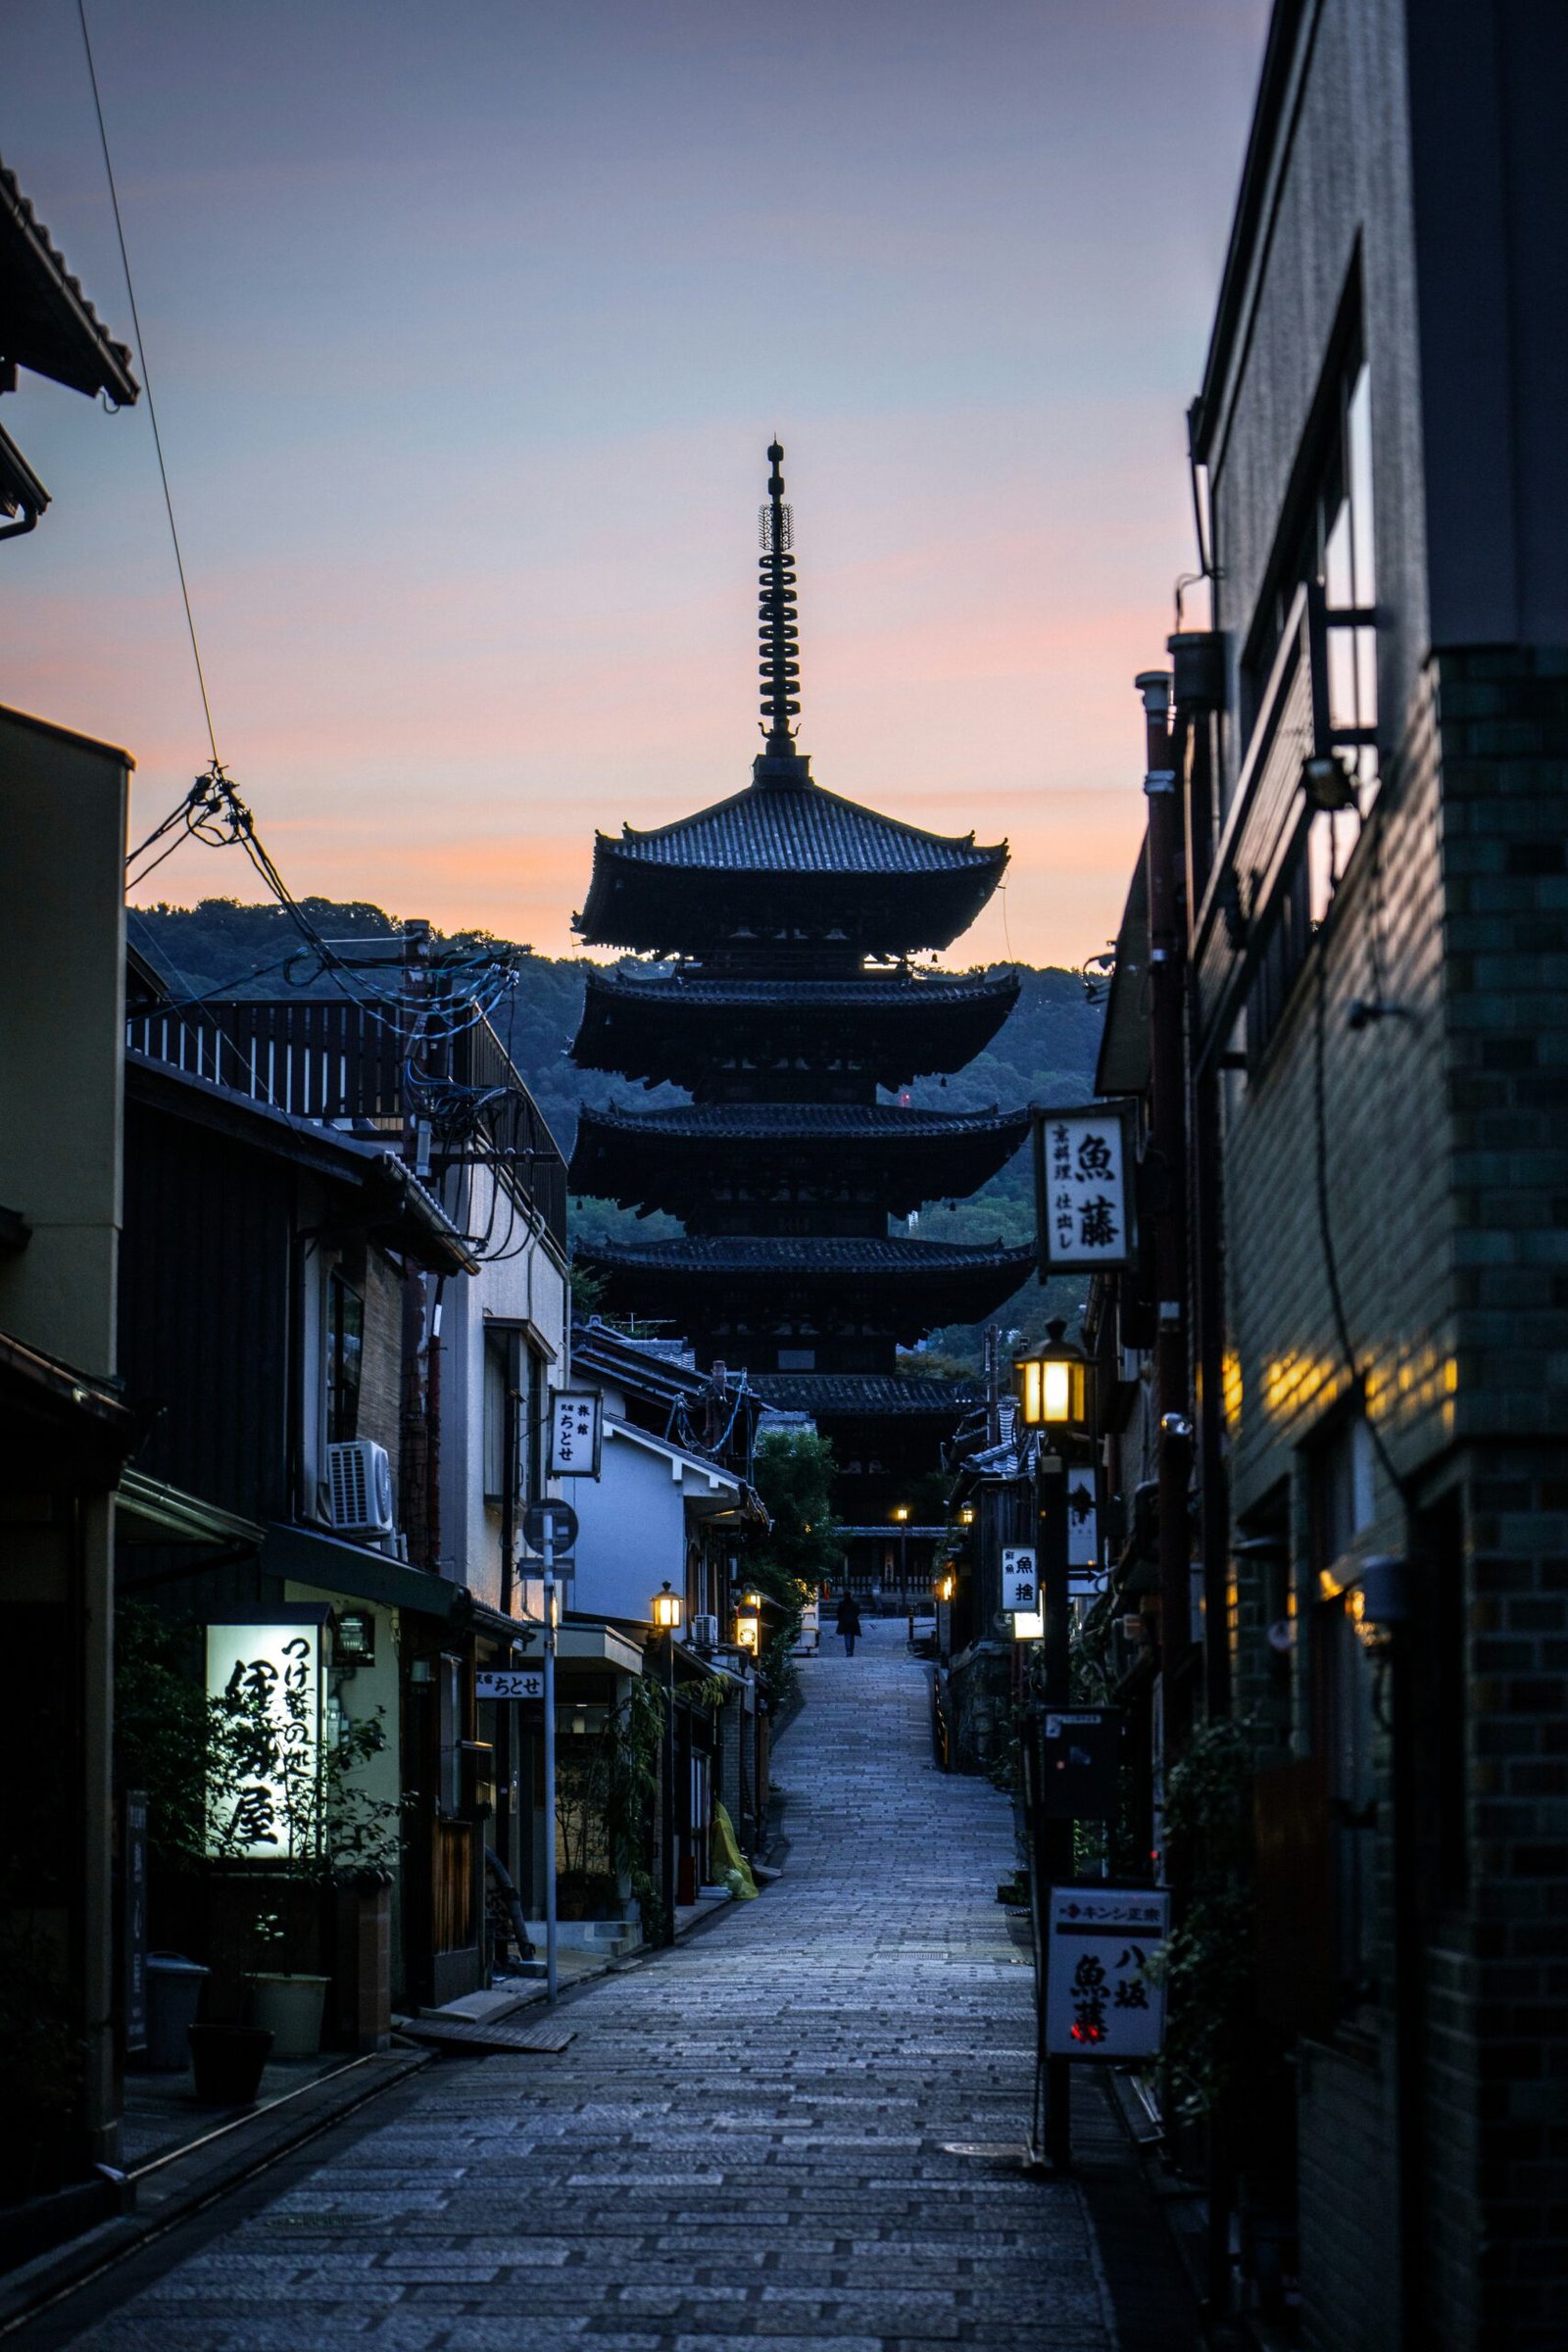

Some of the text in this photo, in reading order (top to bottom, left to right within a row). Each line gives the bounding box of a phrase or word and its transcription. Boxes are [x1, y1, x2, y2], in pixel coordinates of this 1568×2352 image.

[1075, 1133, 1120, 1248] 魚藤
[558, 1414, 574, 1461] ちとせ
[1015, 1556, 1034, 1601] 魚捨
[494, 1676, 541, 1695] ちとせ
[224, 1658, 279, 1845] 伊屋
[1113, 1944, 1150, 2010] 八坂
